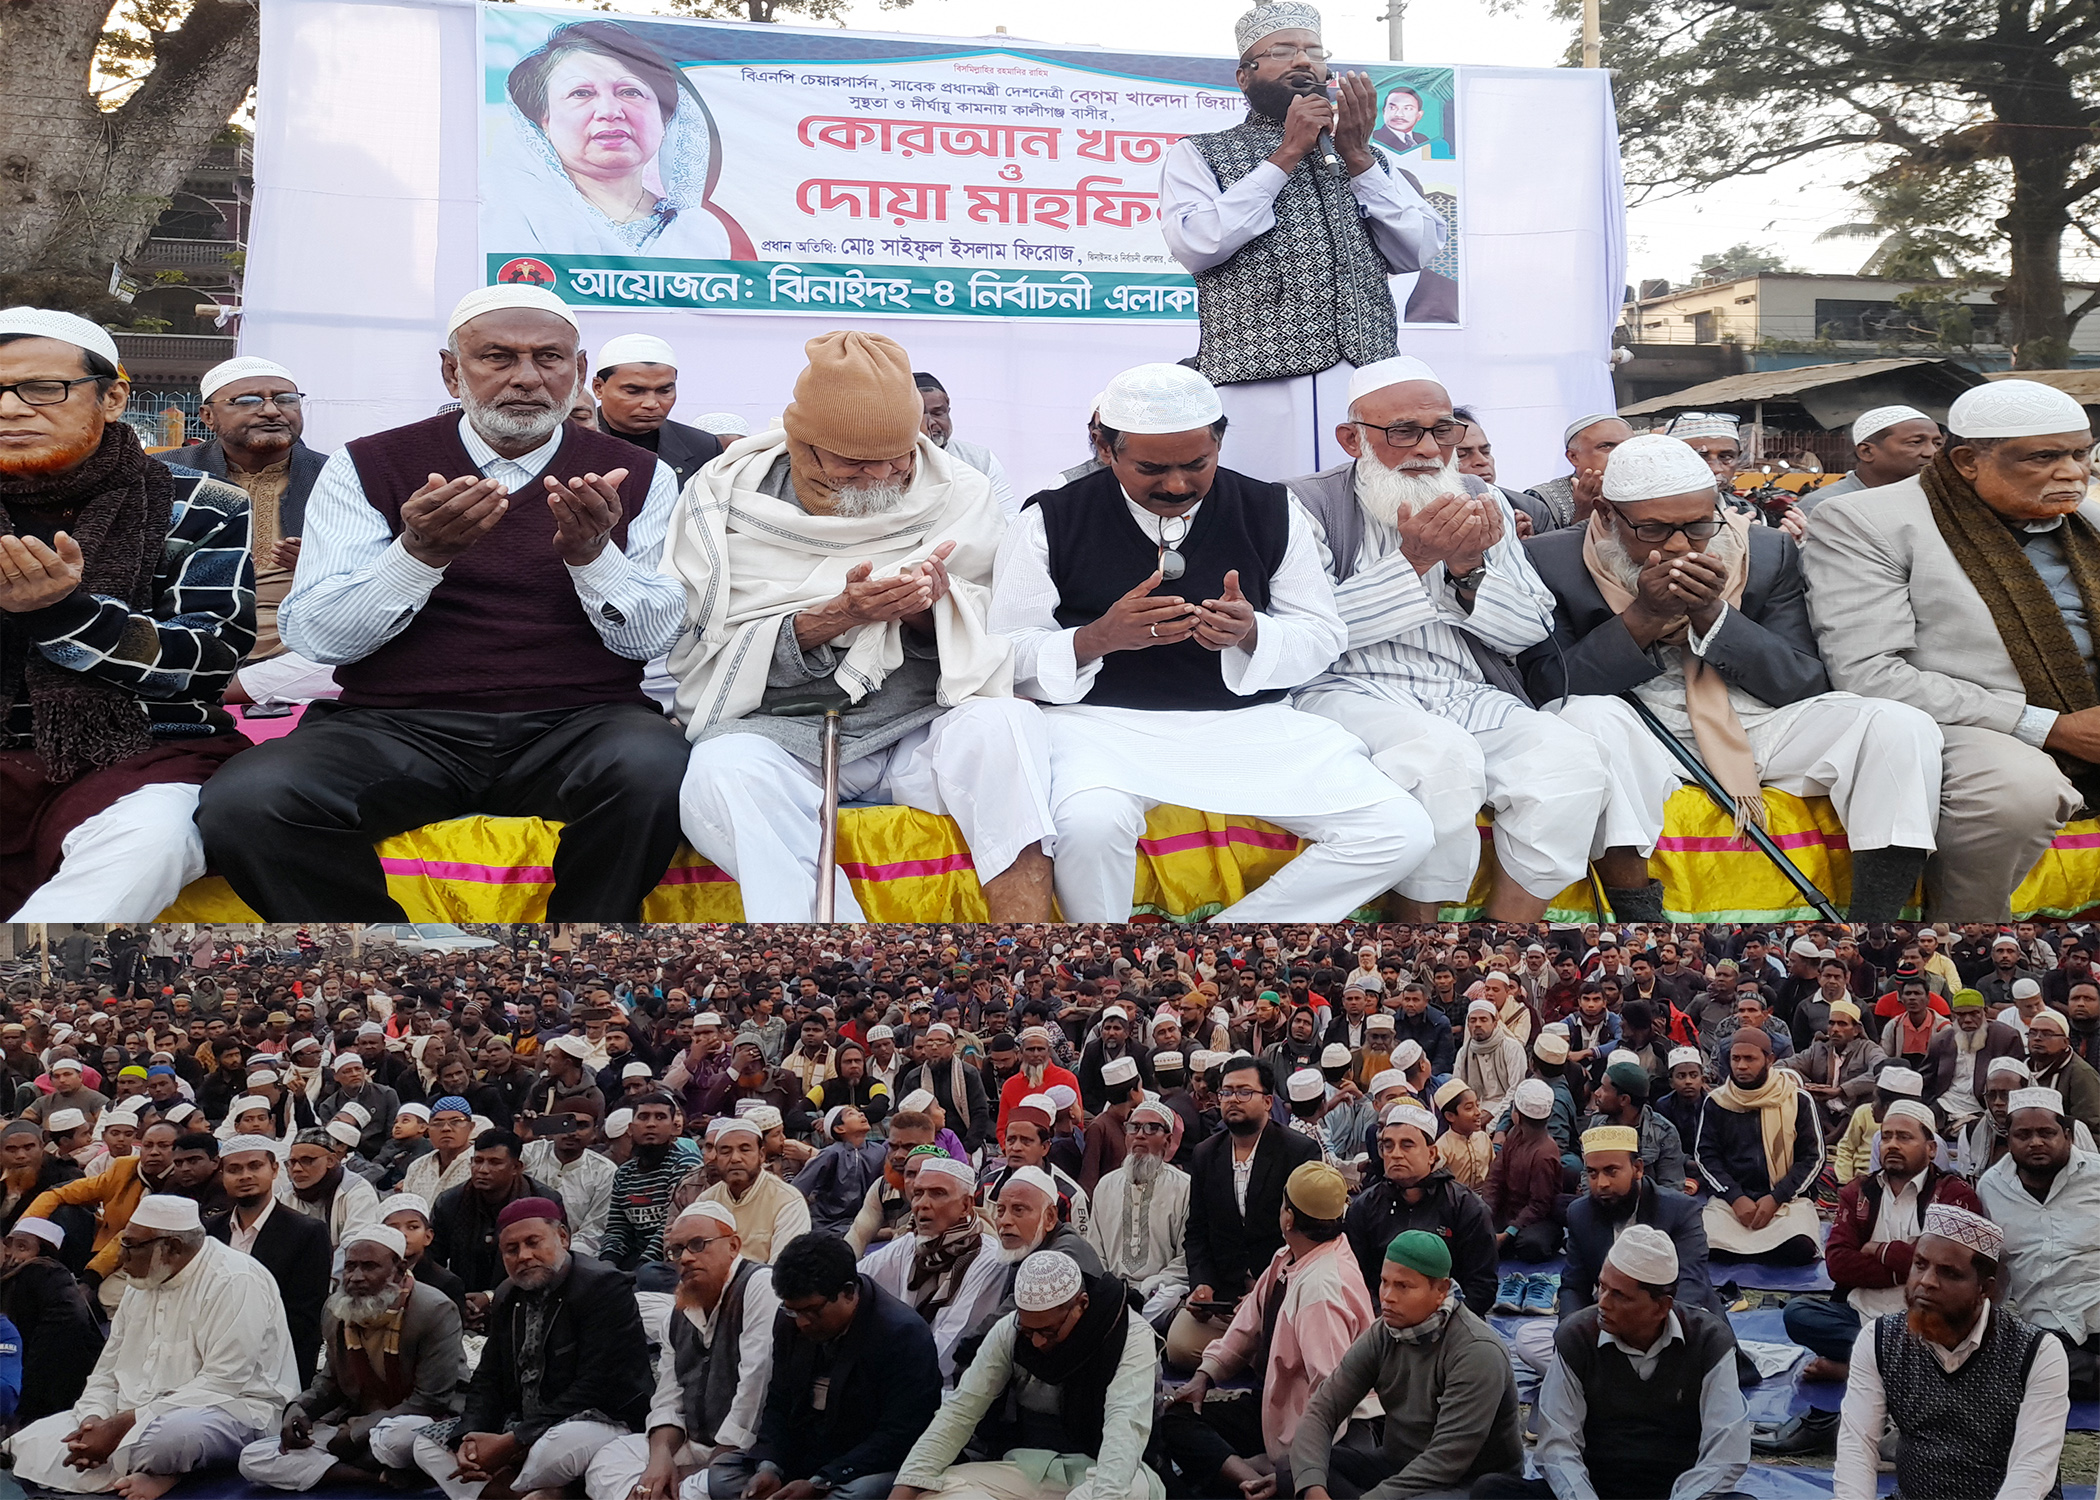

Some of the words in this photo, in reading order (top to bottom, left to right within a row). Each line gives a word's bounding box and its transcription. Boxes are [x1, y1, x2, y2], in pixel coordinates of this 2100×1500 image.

[741, 67, 794, 84] বিএনপি
[800, 71, 886, 92] চেয়ারপার্সন,
[890, 80, 936, 93] সাবেক
[941, 81, 999, 97] প্রধানমন্ত্রী
[1005, 85, 1064, 100] দেশনেত্রী
[1070, 89, 1120, 106] বেগম
[1125, 91, 1189, 109] খালেদা
[997, 67, 1026, 76] রহমানির
[1029, 68, 1049, 77] রাহিম
[894, 99, 906, 109] ও
[911, 96, 952, 115] দীর্ঘায়ু
[957, 102, 1006, 115] কামনায়
[1013, 103, 1065, 119] কালীগঞ্জ
[1070, 105, 1115, 123] বাসীর,
[797, 115, 1062, 160] কোরআন
[1076, 129, 1193, 163] খত
[999, 164, 1024, 181] ও
[796, 178, 952, 226] দোয়া
[963, 175, 1162, 230] মাহফি
[761, 240, 791, 253] প্রধান
[796, 238, 837, 254] অতিথি:
[841, 238, 875, 255] মোঃ
[881, 235, 944, 263] সাইফুল
[949, 236, 1008, 260] ইসলাম
[1013, 238, 1083, 266] ফিরোজ,
[568, 268, 754, 302] আয়োজনে:
[767, 263, 955, 309] ঝিনাইদহ-৪
[968, 269, 1094, 311] নির্বাচনী
